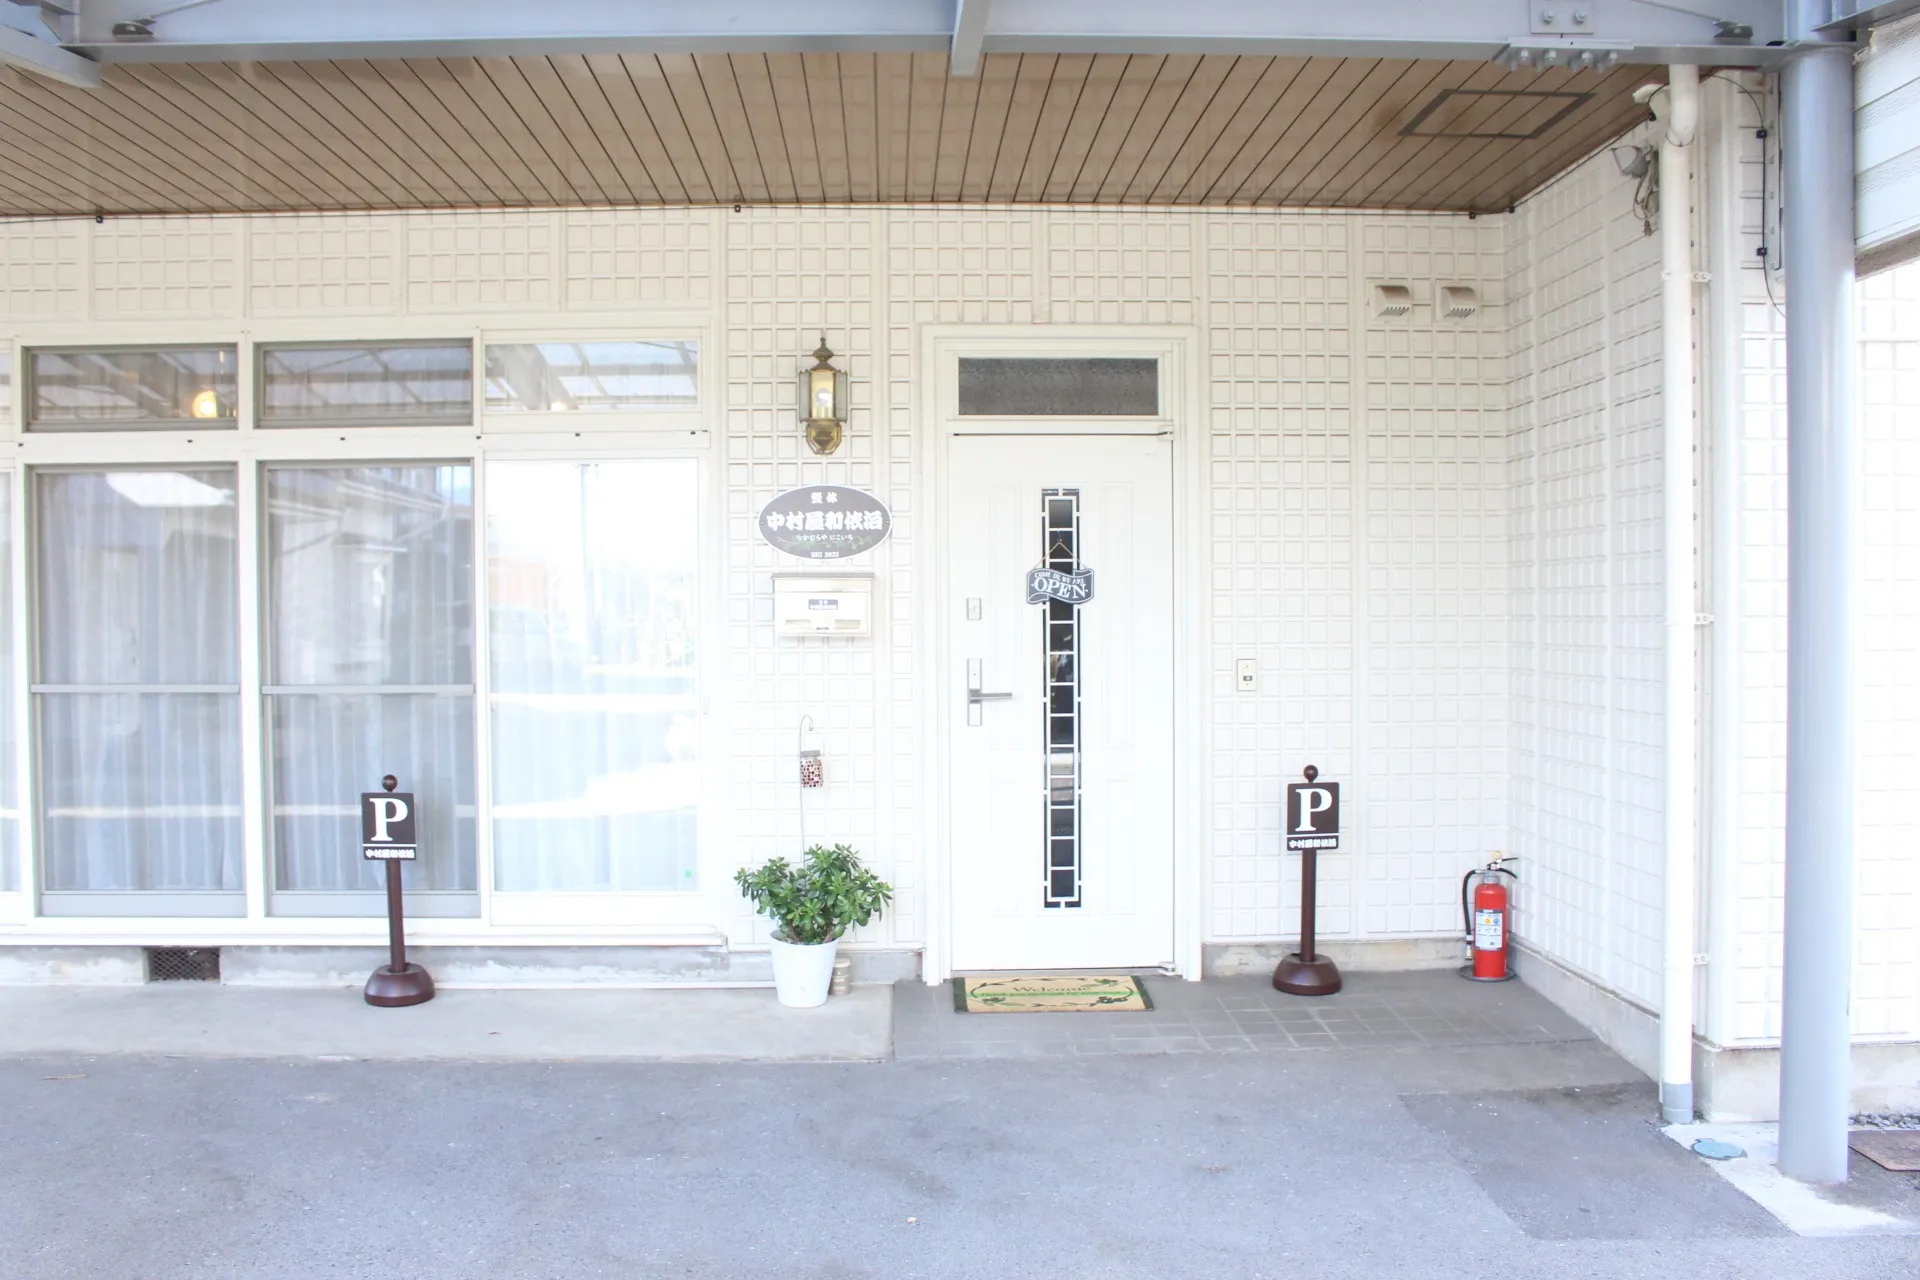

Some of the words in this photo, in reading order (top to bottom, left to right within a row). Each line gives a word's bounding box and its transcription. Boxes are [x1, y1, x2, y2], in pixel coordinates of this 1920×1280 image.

[1034, 577, 1086, 599] OPEN
[369, 798, 408, 841] P
[1295, 788, 1332, 831] P
